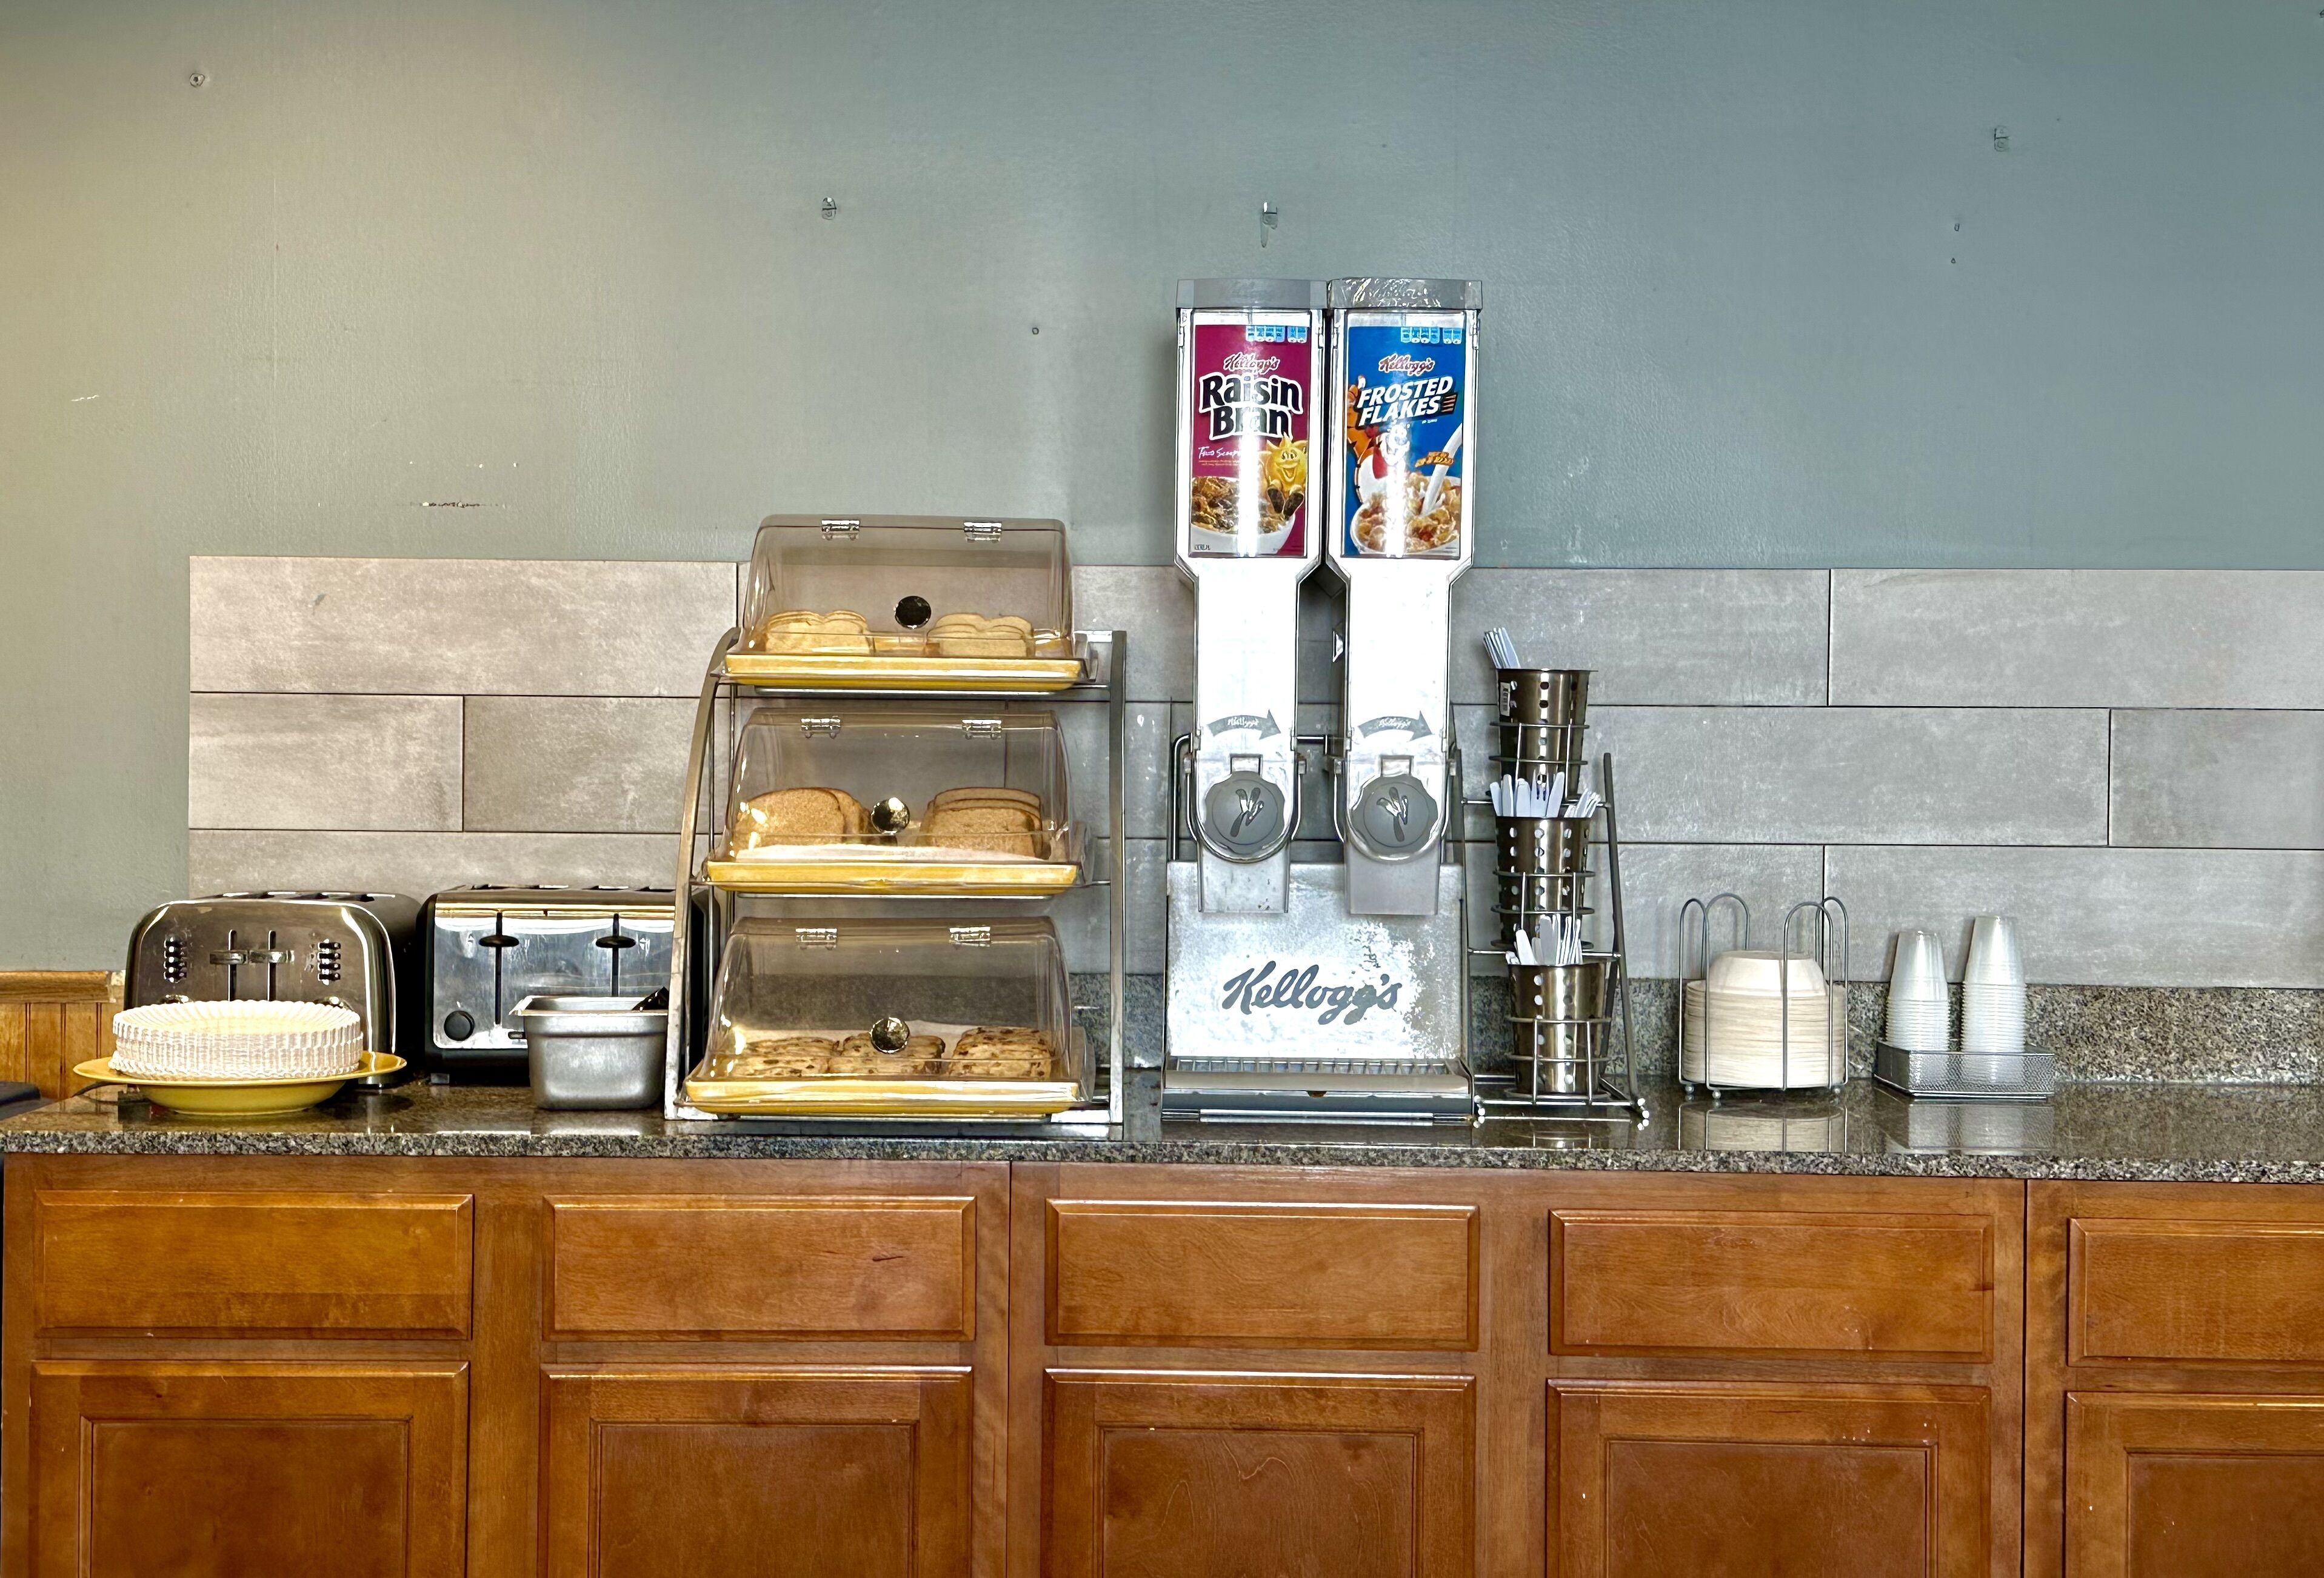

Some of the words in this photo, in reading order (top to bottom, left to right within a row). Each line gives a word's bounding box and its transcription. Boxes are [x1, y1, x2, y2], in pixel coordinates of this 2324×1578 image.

[1223, 351, 1281, 375] Kellogg's
[1378, 353, 1435, 376] Kellogg's
[1200, 373, 1302, 413] Raisin
[1357, 376, 1453, 408] FROSTED
[1211, 405, 1292, 439] Bran
[1358, 396, 1441, 427] FLAKES
[1222, 960, 1403, 1025] Kellogg's
